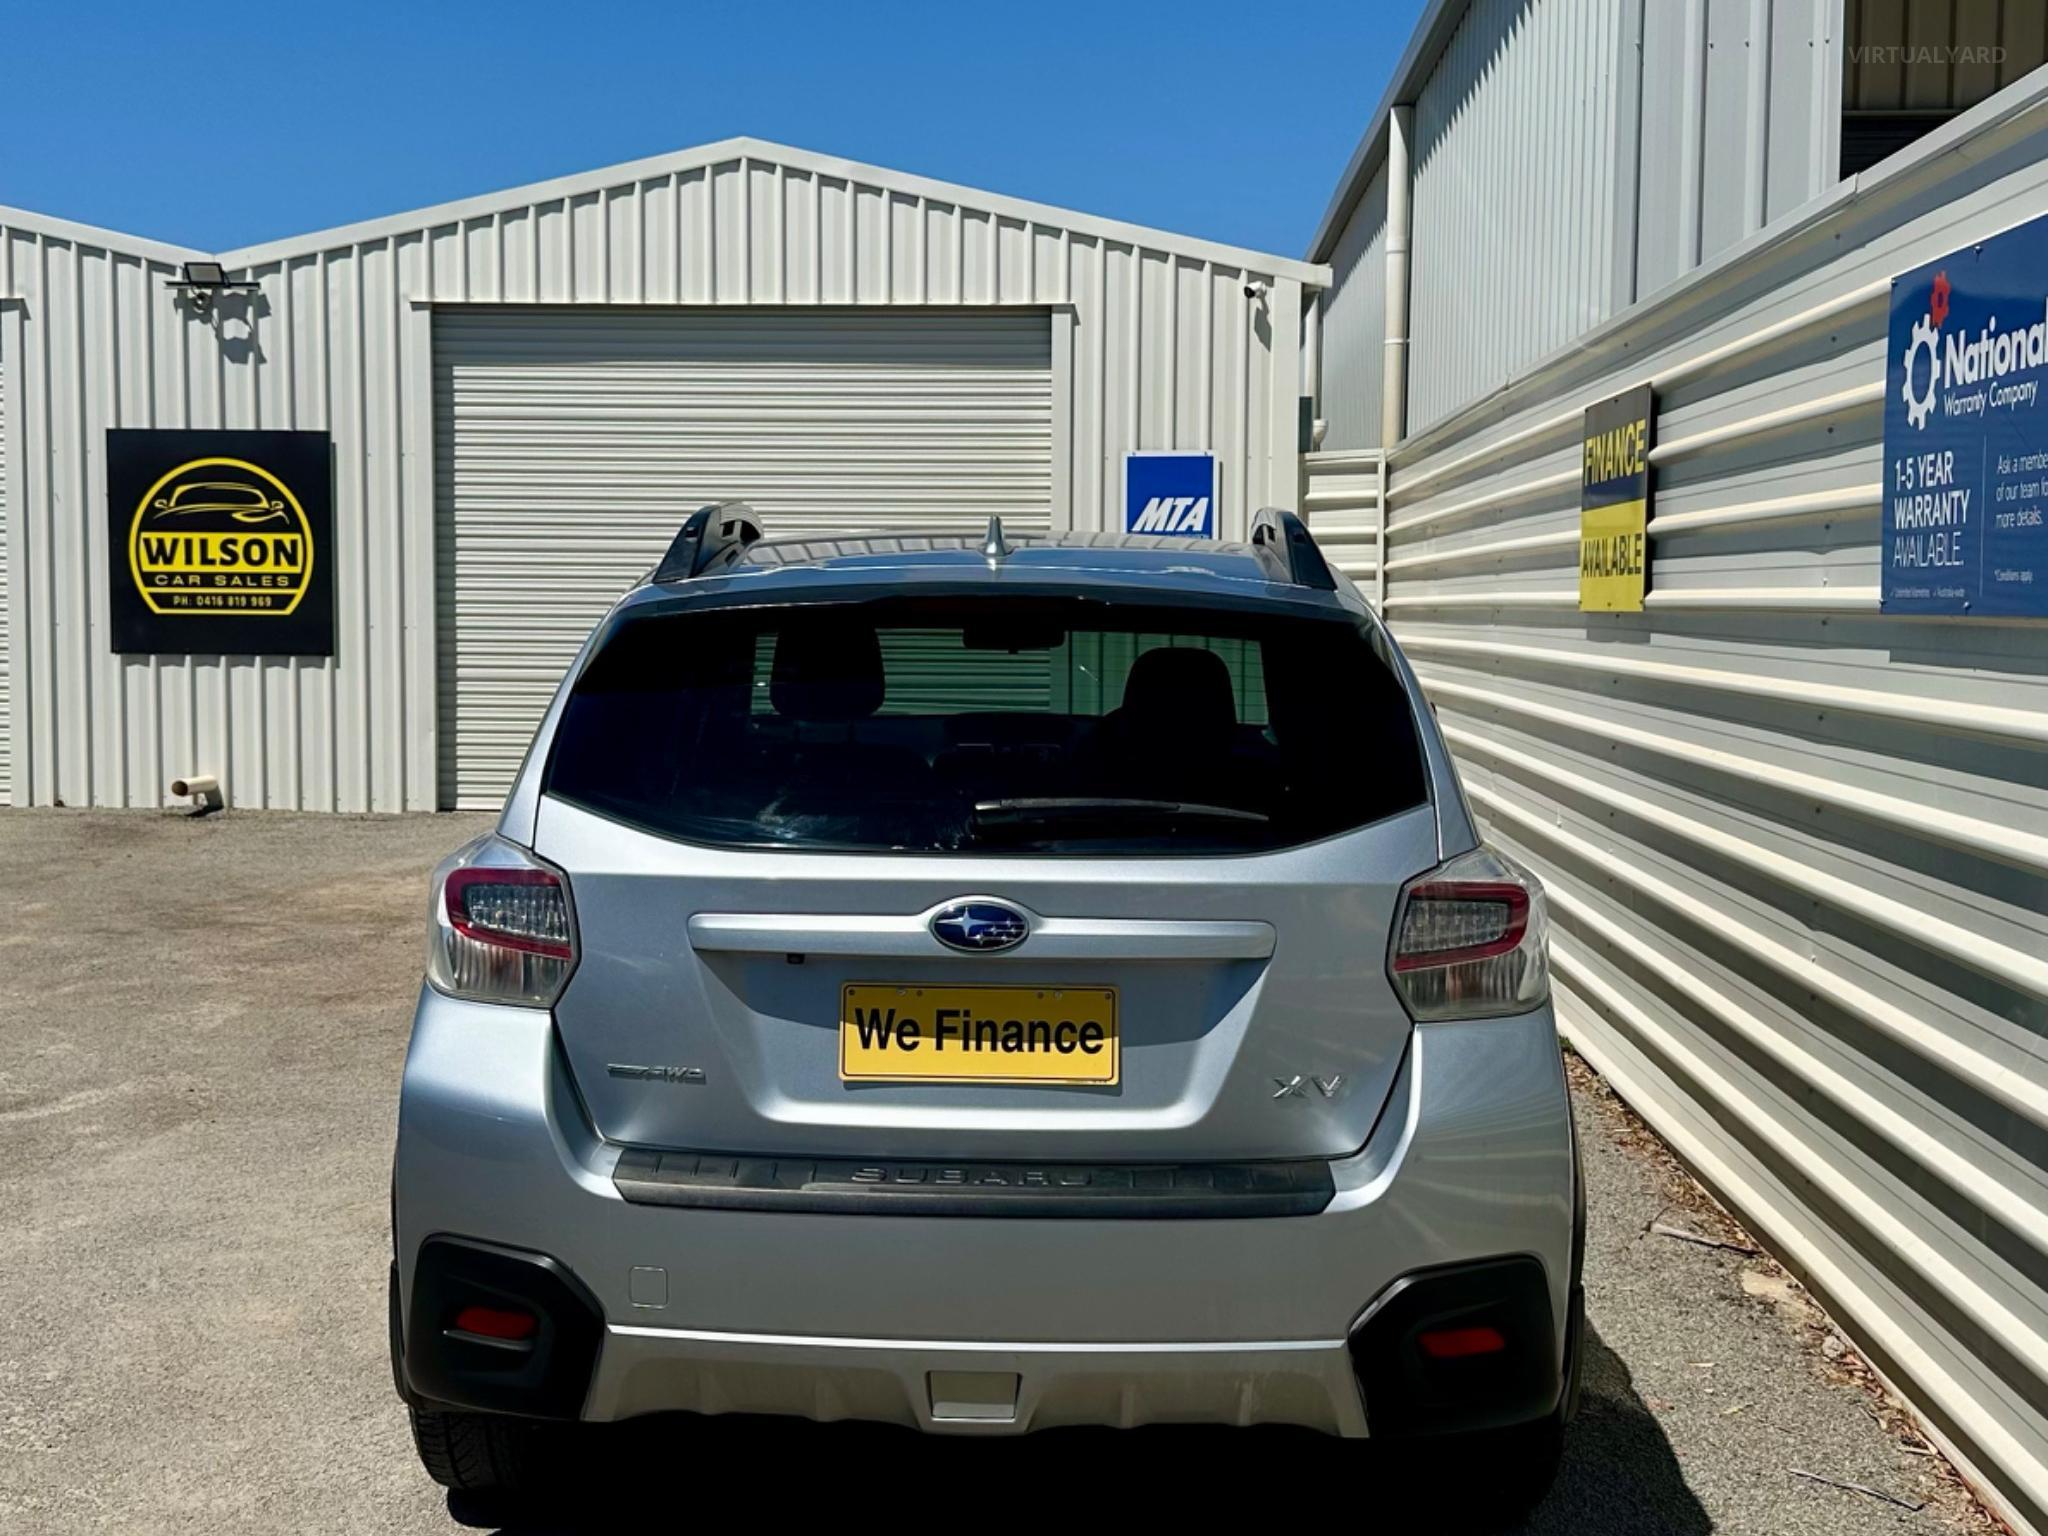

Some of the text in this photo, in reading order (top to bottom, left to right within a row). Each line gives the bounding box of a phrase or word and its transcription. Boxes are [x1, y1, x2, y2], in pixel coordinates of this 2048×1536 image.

[1944, 380, 2038, 418] Warranty Company
[1584, 418, 1646, 488] FINANCE
[1997, 454, 2011, 475] Ask
[2013, 458, 2018, 473] a
[1895, 450, 1953, 492] 1-5 YEAR
[2020, 480, 2040, 499] team
[1131, 497, 1209, 532] MTA
[1894, 488, 1971, 530] WARRANTY
[1996, 511, 2015, 528] more
[143, 537, 299, 567] WILSON
[1581, 532, 1643, 578] AVAILABLE
[155, 575, 290, 587] CAR SALES
[854, 1008, 1104, 1055] We Finance
[851, 1167, 1092, 1186] SUBARU
